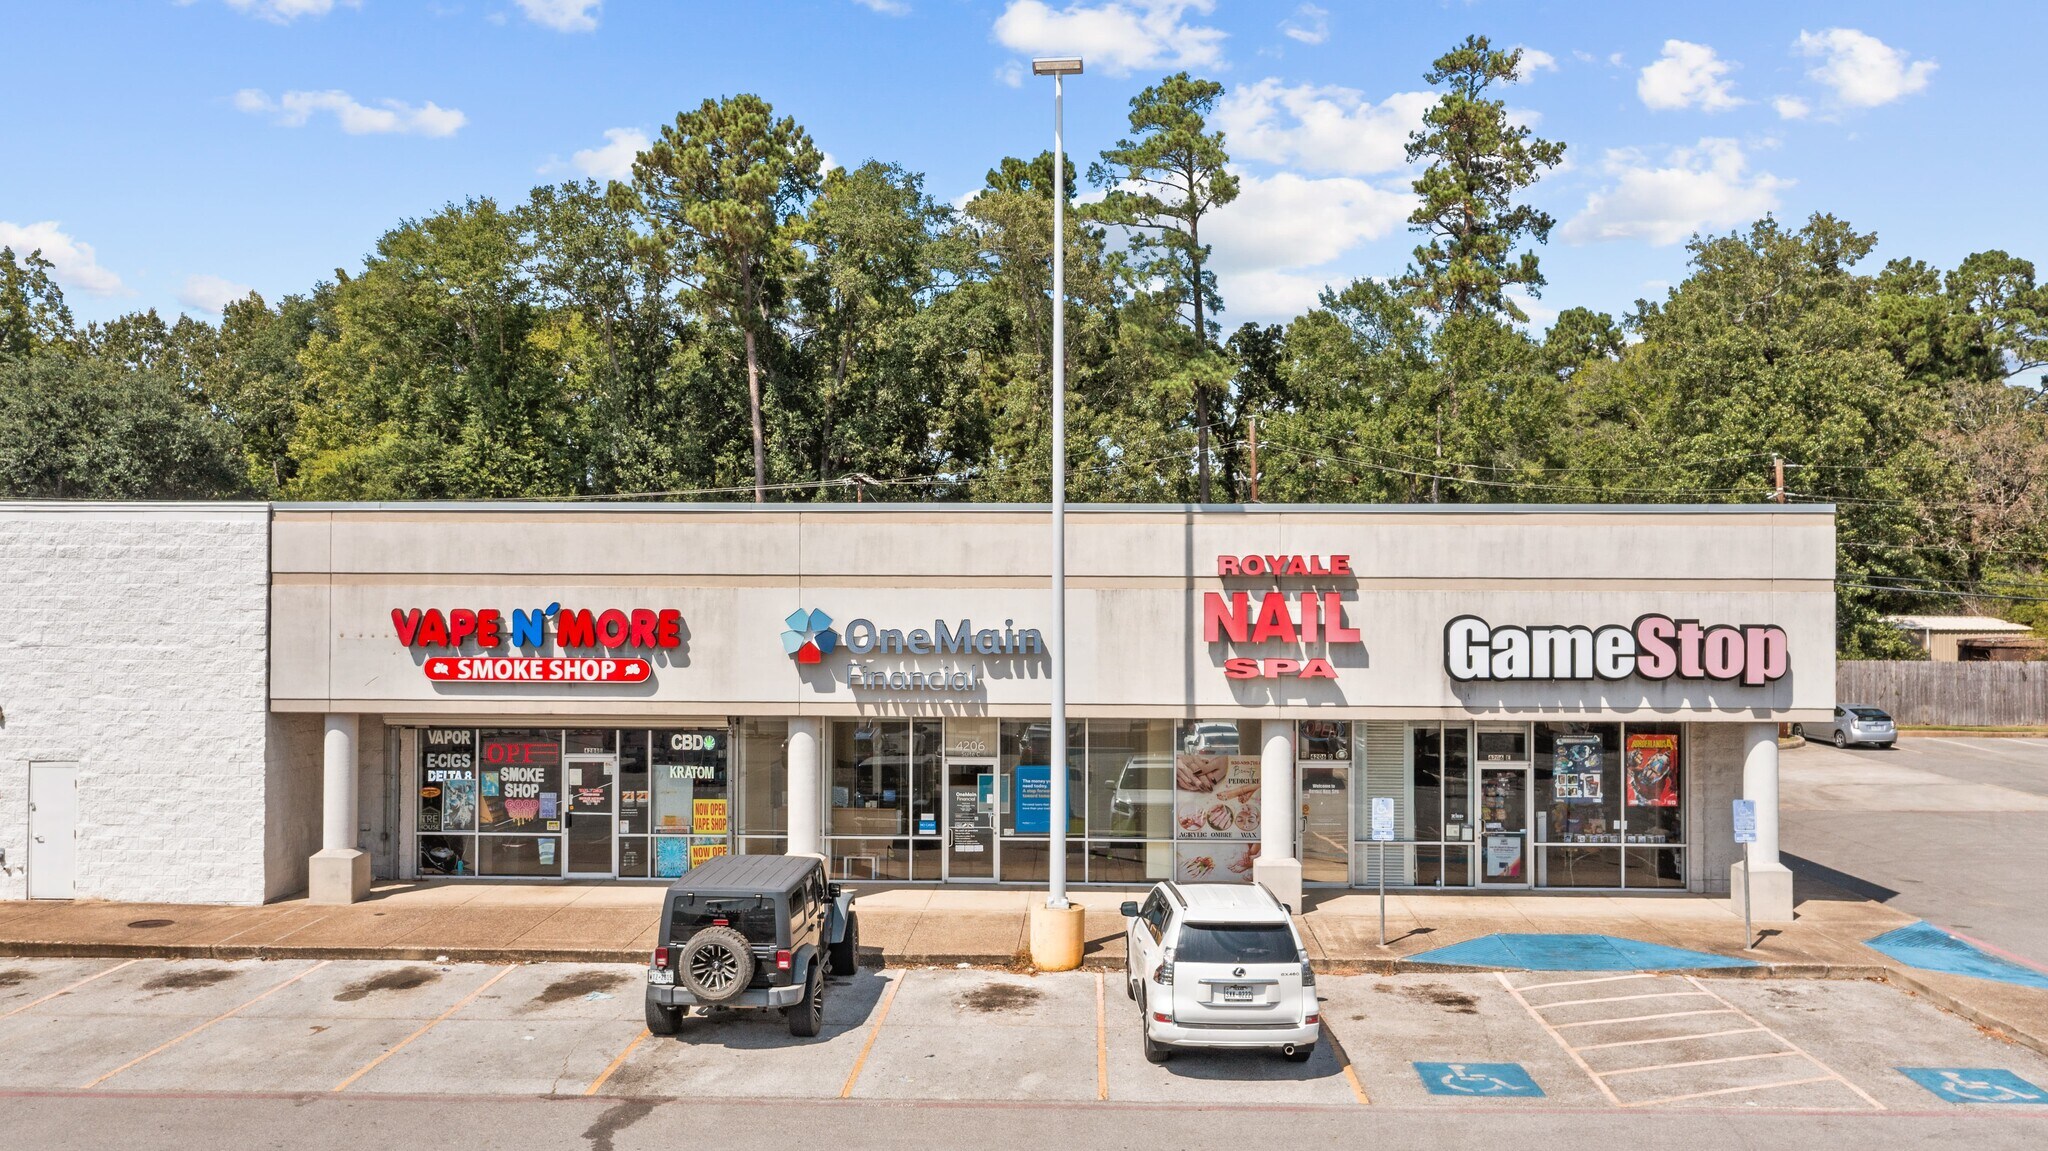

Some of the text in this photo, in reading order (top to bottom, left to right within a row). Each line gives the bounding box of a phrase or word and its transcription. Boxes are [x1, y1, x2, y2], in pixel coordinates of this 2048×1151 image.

[1217, 555, 1350, 576] ROYALE
[1204, 592, 1360, 642] NAIL
[391, 607, 500, 647] VAPE
[845, 618, 1042, 655] OneMain
[1443, 612, 1788, 687] GameStop
[457, 660, 616, 681] SMOKE SHOP
[1224, 658, 1339, 679] SPA
[847, 664, 977, 691] Financial
[427, 730, 471, 744] VAPOR
[671, 734, 703, 750] CBD
[956, 740, 986, 751] 4206
[427, 753, 471, 768] E-CIGS
[428, 770, 462, 782] DELTA
[500, 767, 545, 782] SMOKE
[669, 766, 715, 779] KRATOM
[504, 783, 540, 798] SHOP
[695, 802, 726, 816] NOW OPEN
[695, 817, 710, 831] VAPE
[711, 817, 727, 831] SHOP
[692, 846, 727, 858] NOW OPE
